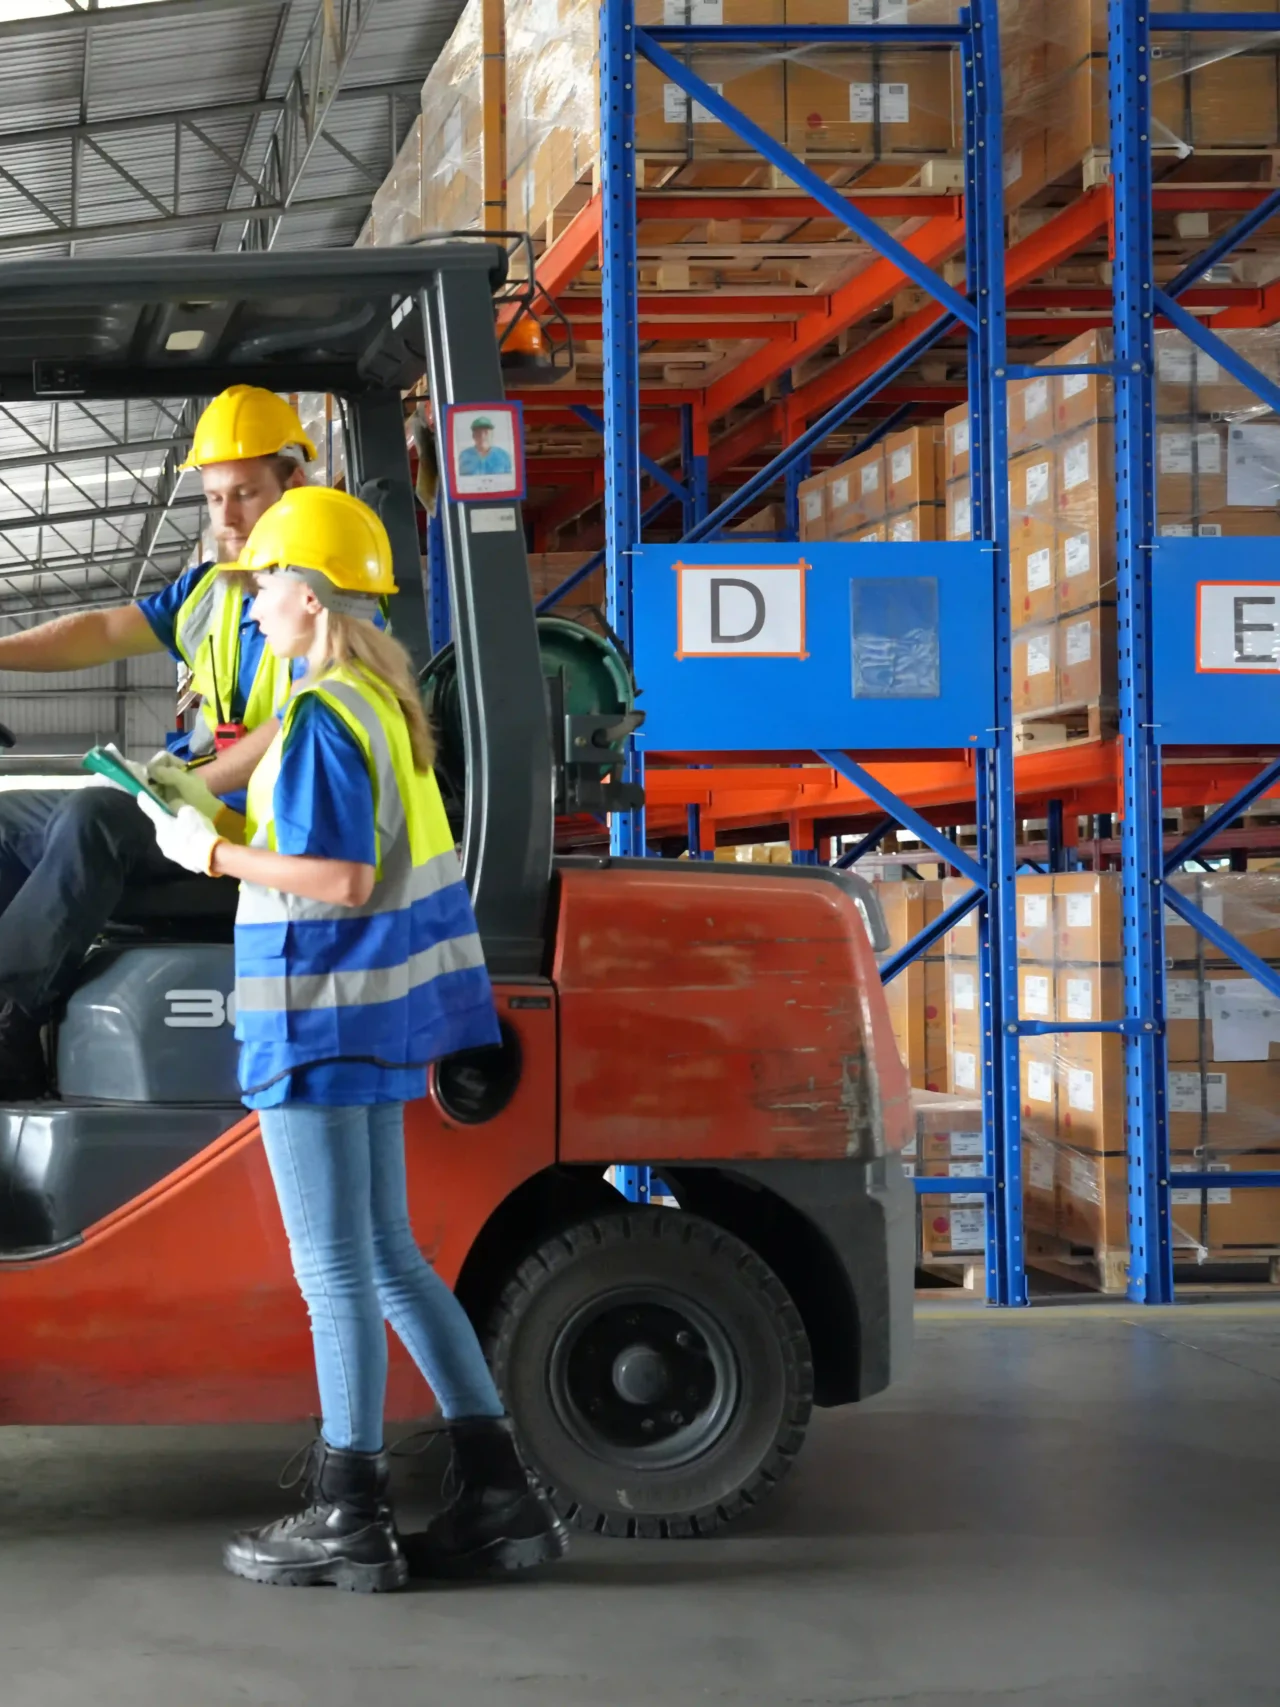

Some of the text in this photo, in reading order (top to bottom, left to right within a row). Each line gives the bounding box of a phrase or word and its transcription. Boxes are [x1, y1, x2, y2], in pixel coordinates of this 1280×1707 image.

[710, 577, 766, 644] D
[1233, 596, 1278, 663] E
[163, 989, 236, 1028] 3
